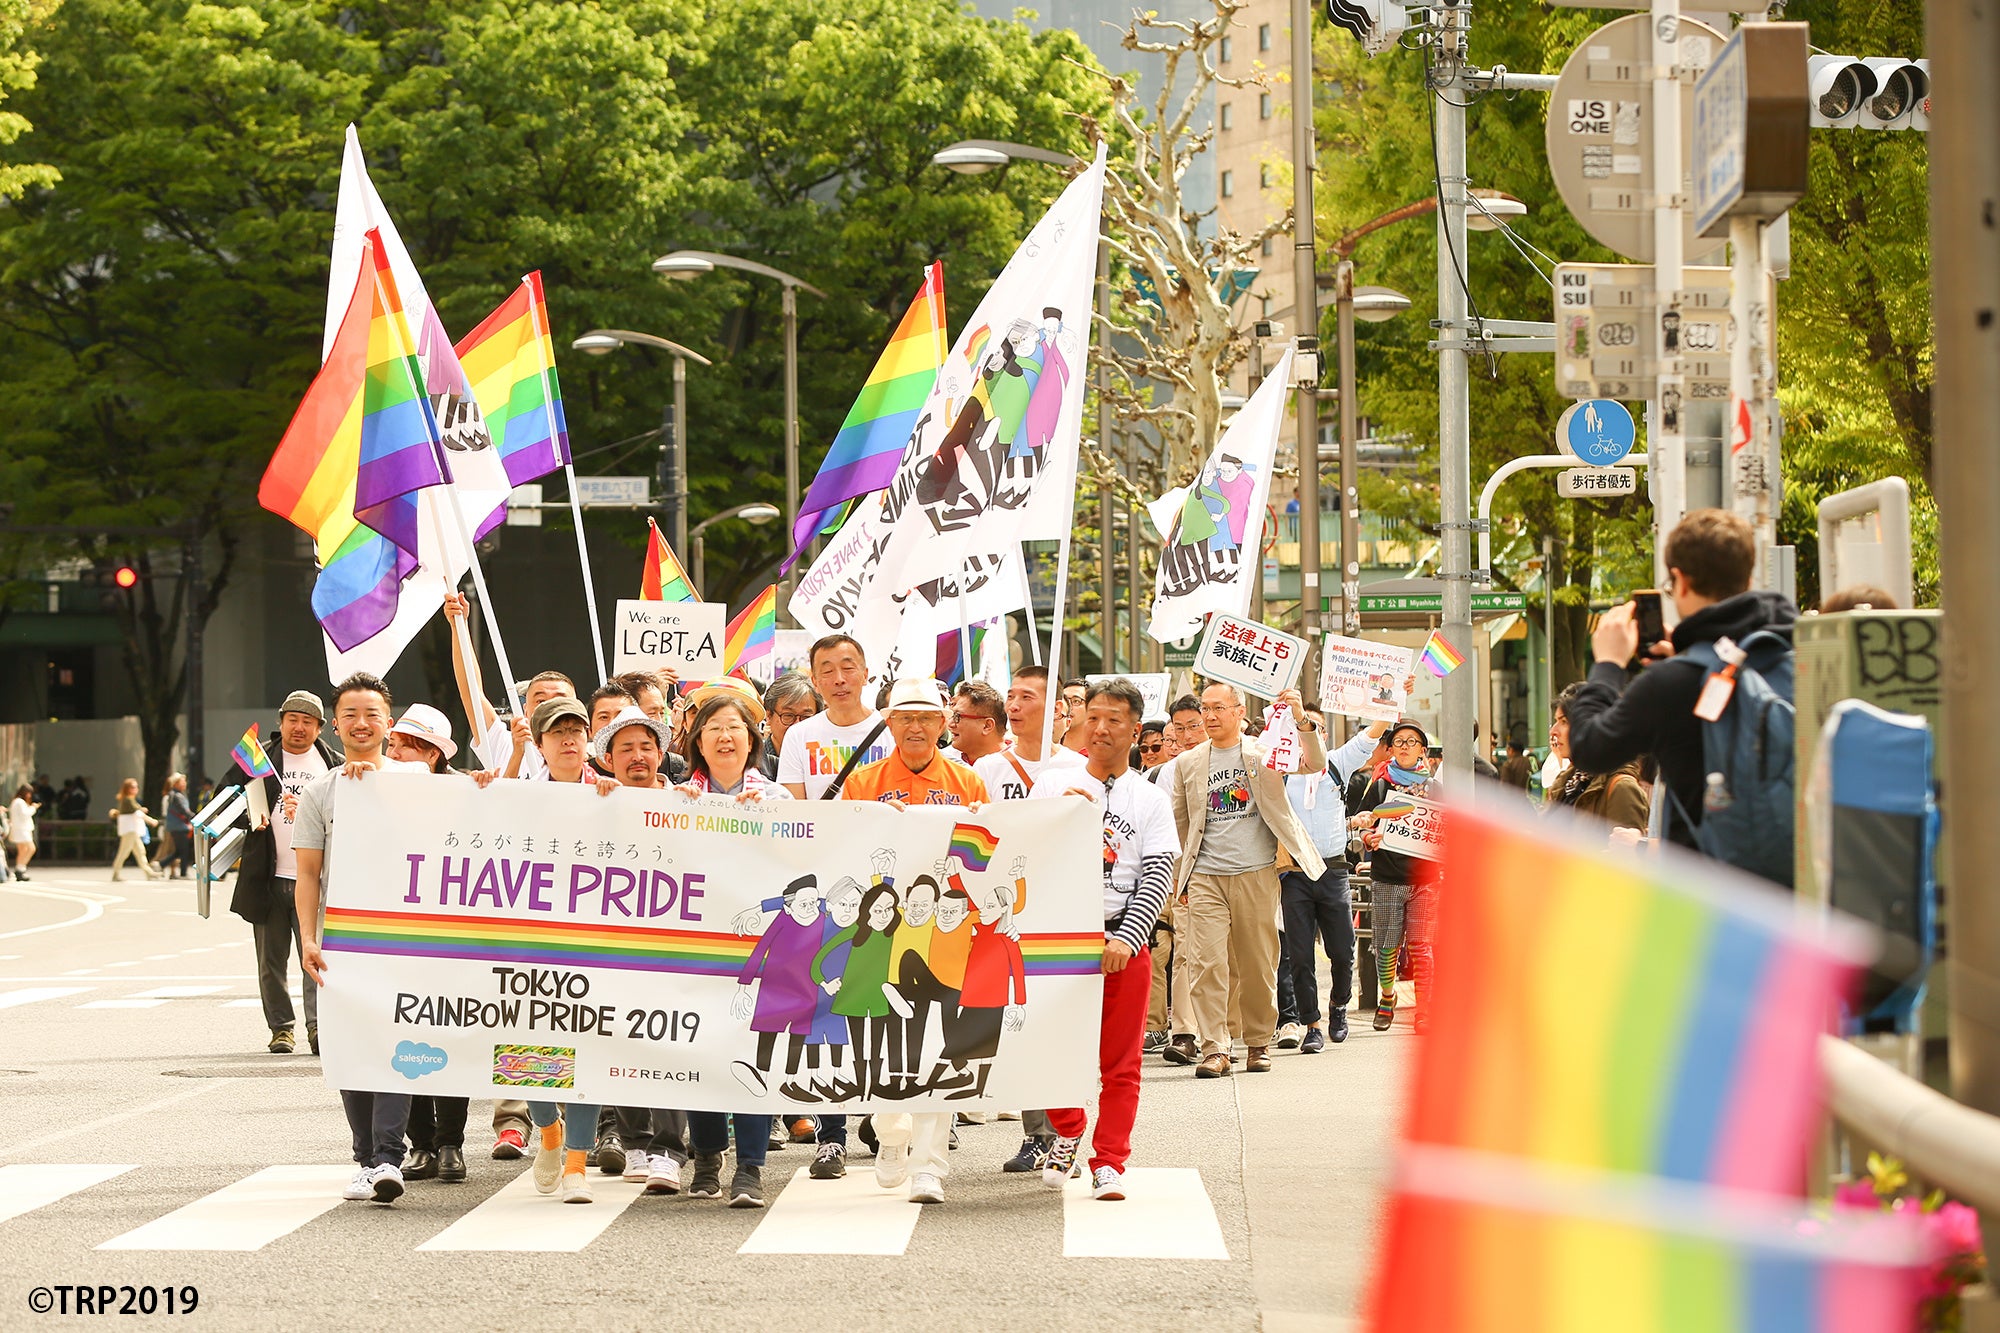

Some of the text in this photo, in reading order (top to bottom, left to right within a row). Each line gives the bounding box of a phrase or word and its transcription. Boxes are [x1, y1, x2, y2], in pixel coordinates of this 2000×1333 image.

[1575, 101, 1605, 119] JS
[1571, 120, 1610, 133] ONE
[1562, 274, 1586, 287] KU
[1563, 292, 1586, 305] SU
[1572, 474, 1631, 489] 歩行者優先
[1367, 599, 1407, 609] 宮下公園
[629, 610, 681, 626] We are
[1219, 620, 1290, 660] 法律上も
[1212, 639, 1279, 676] 家族に！
[1326, 683, 1344, 694] FOR
[1327, 674, 1367, 689] MARRIAGE
[1325, 692, 1339, 702] ALL
[1323, 701, 1347, 712] JAPAN
[643, 811, 815, 839] TOKYO RAINBOW PRIDE
[1103, 810, 1137, 841] PRIDE
[444, 831, 675, 864] あるがままを誇ろう。
[403, 853, 706, 922] I HAVE PRIDE
[491, 966, 590, 999] TOKYO
[393, 992, 701, 1043] RAINBOW PRIDE 2019
[398, 1052, 443, 1065] salesforce
[609, 1067, 700, 1083] BIZREACH
